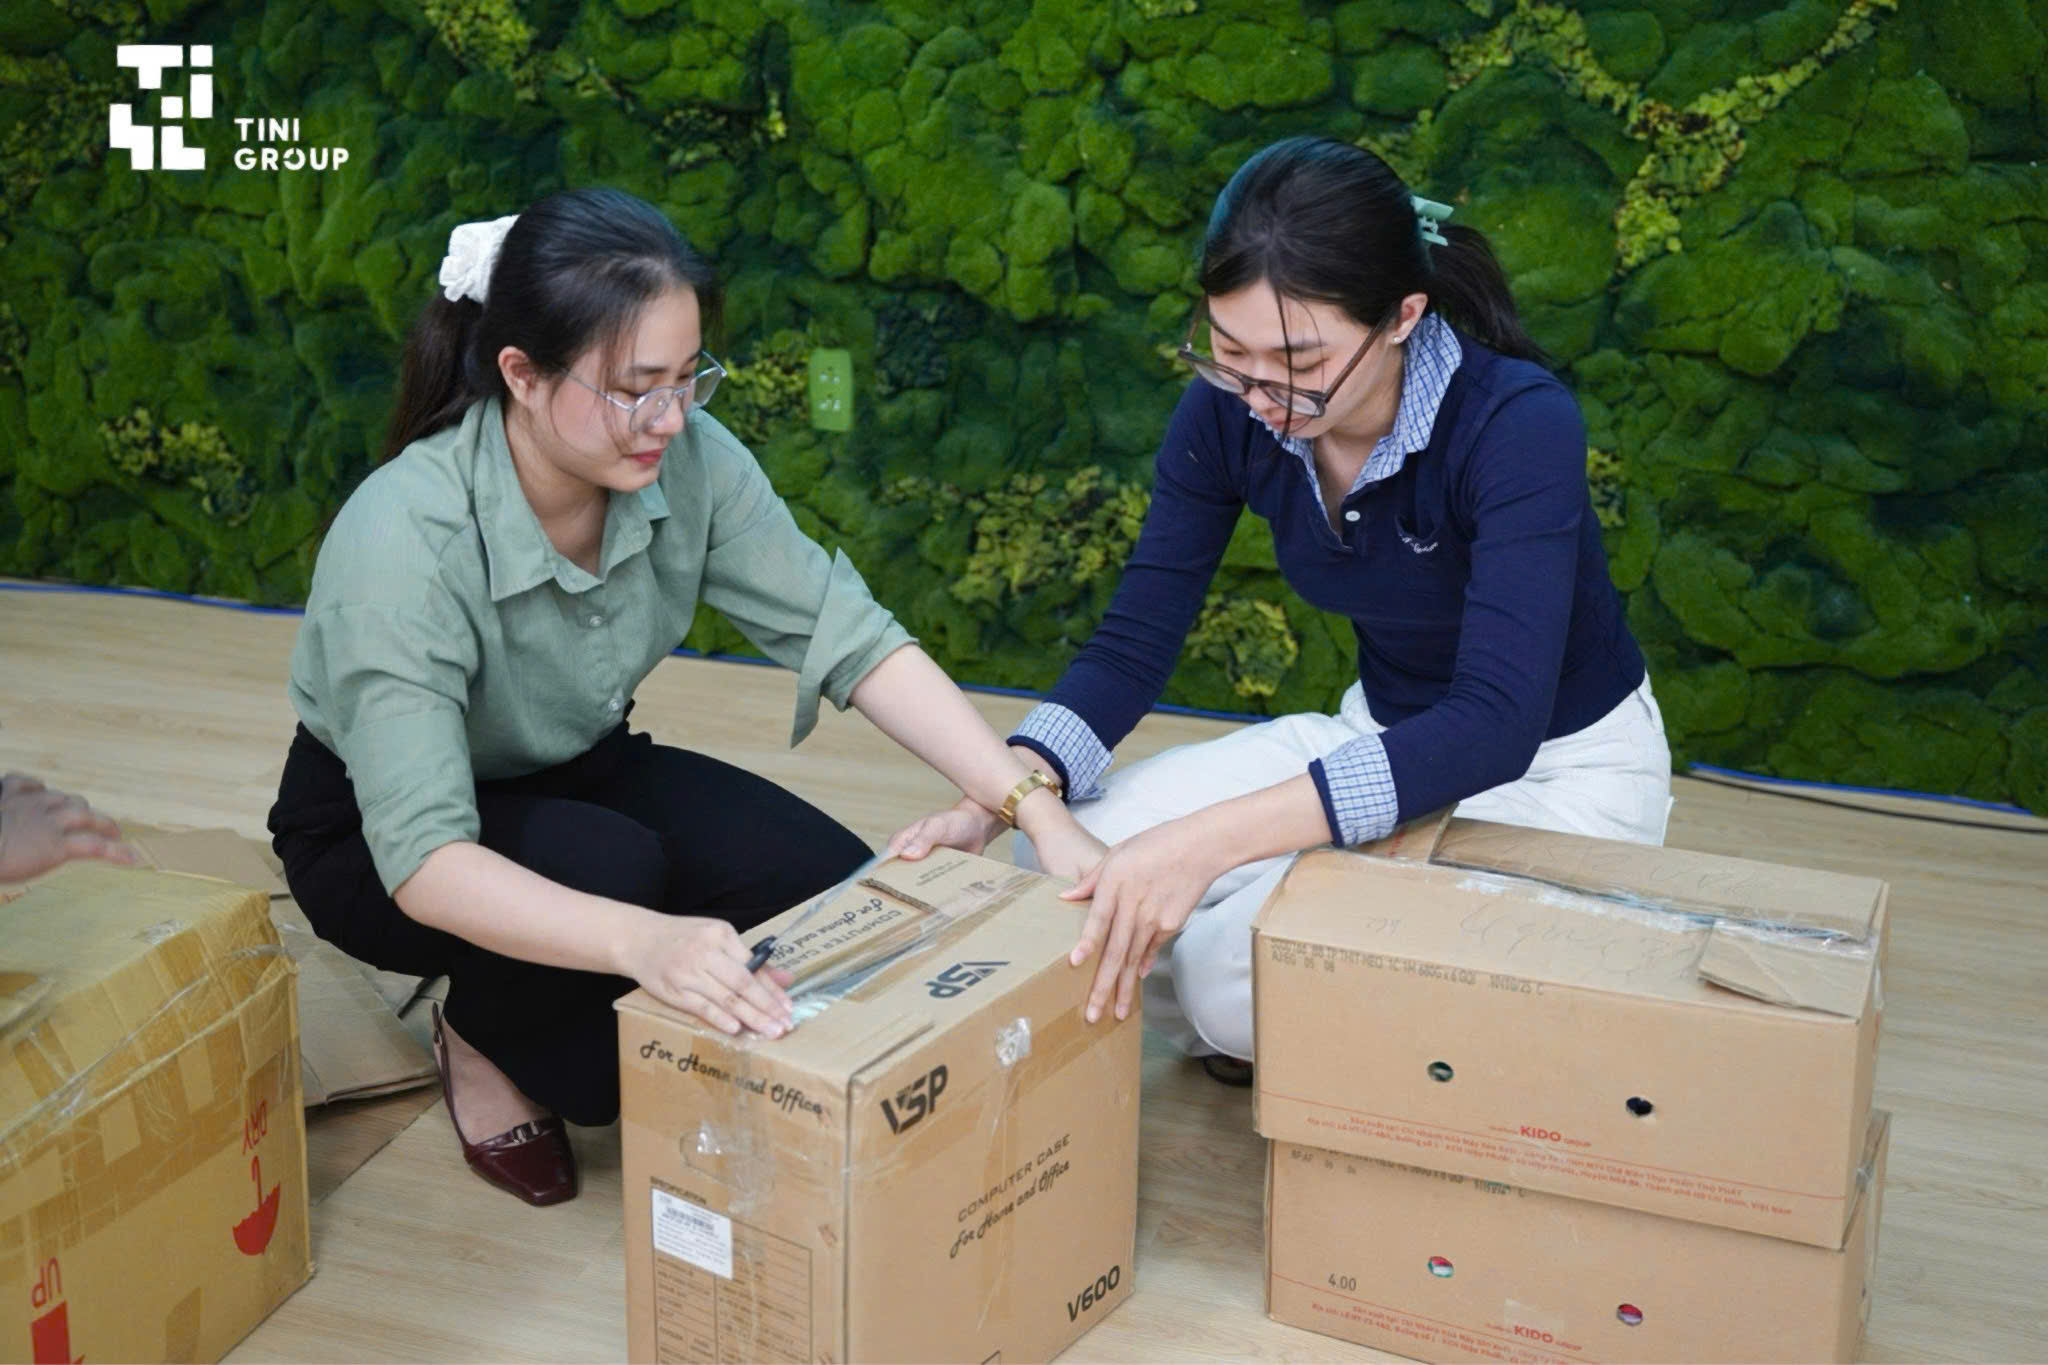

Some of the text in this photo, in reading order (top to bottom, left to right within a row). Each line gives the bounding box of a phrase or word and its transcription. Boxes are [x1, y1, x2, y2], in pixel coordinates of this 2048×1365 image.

[639, 1040, 674, 1064] For
[677, 1053, 731, 1083] Home
[770, 1083, 823, 1115] Office
[242, 1099, 268, 1156] DRY
[1520, 1125, 1562, 1143] KIDO
[957, 1133, 1071, 1224] COMPUTER CASE
[949, 1160, 1070, 1260] For Home and Office
[31, 1256, 62, 1309] UP
[1066, 1264, 1121, 1323] V600
[1327, 1273, 1358, 1292] 4.00
[1513, 1324, 1554, 1344] KIDO
